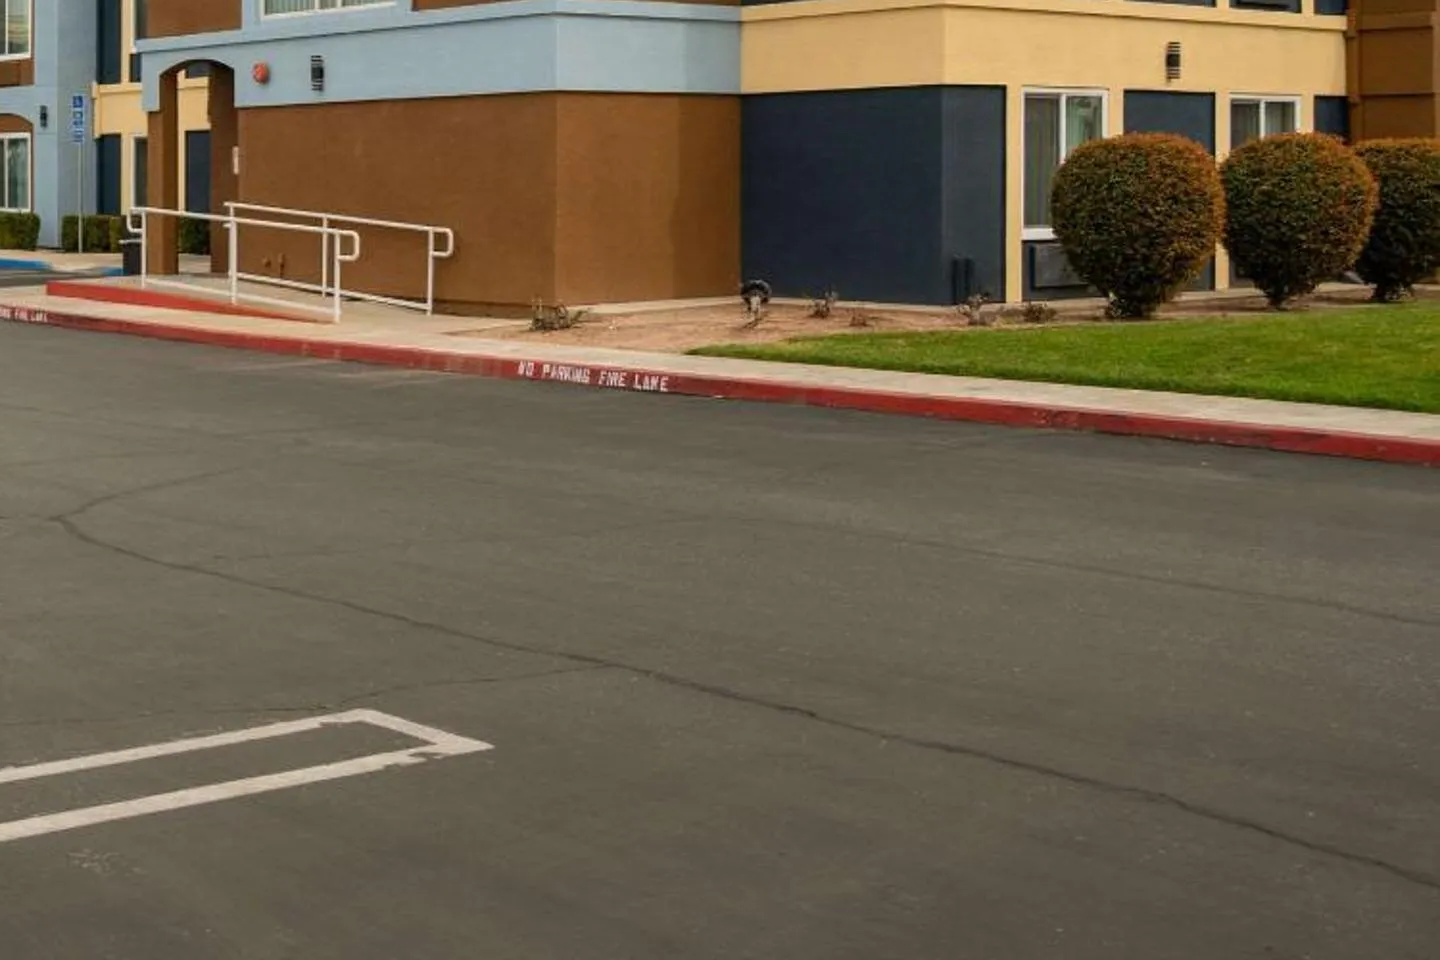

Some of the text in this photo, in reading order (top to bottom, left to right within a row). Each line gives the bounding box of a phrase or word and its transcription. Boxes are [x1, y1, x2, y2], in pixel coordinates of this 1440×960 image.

[517, 360, 535, 378] NO
[541, 364, 591, 385] PARKING
[633, 374, 669, 392] LANE
